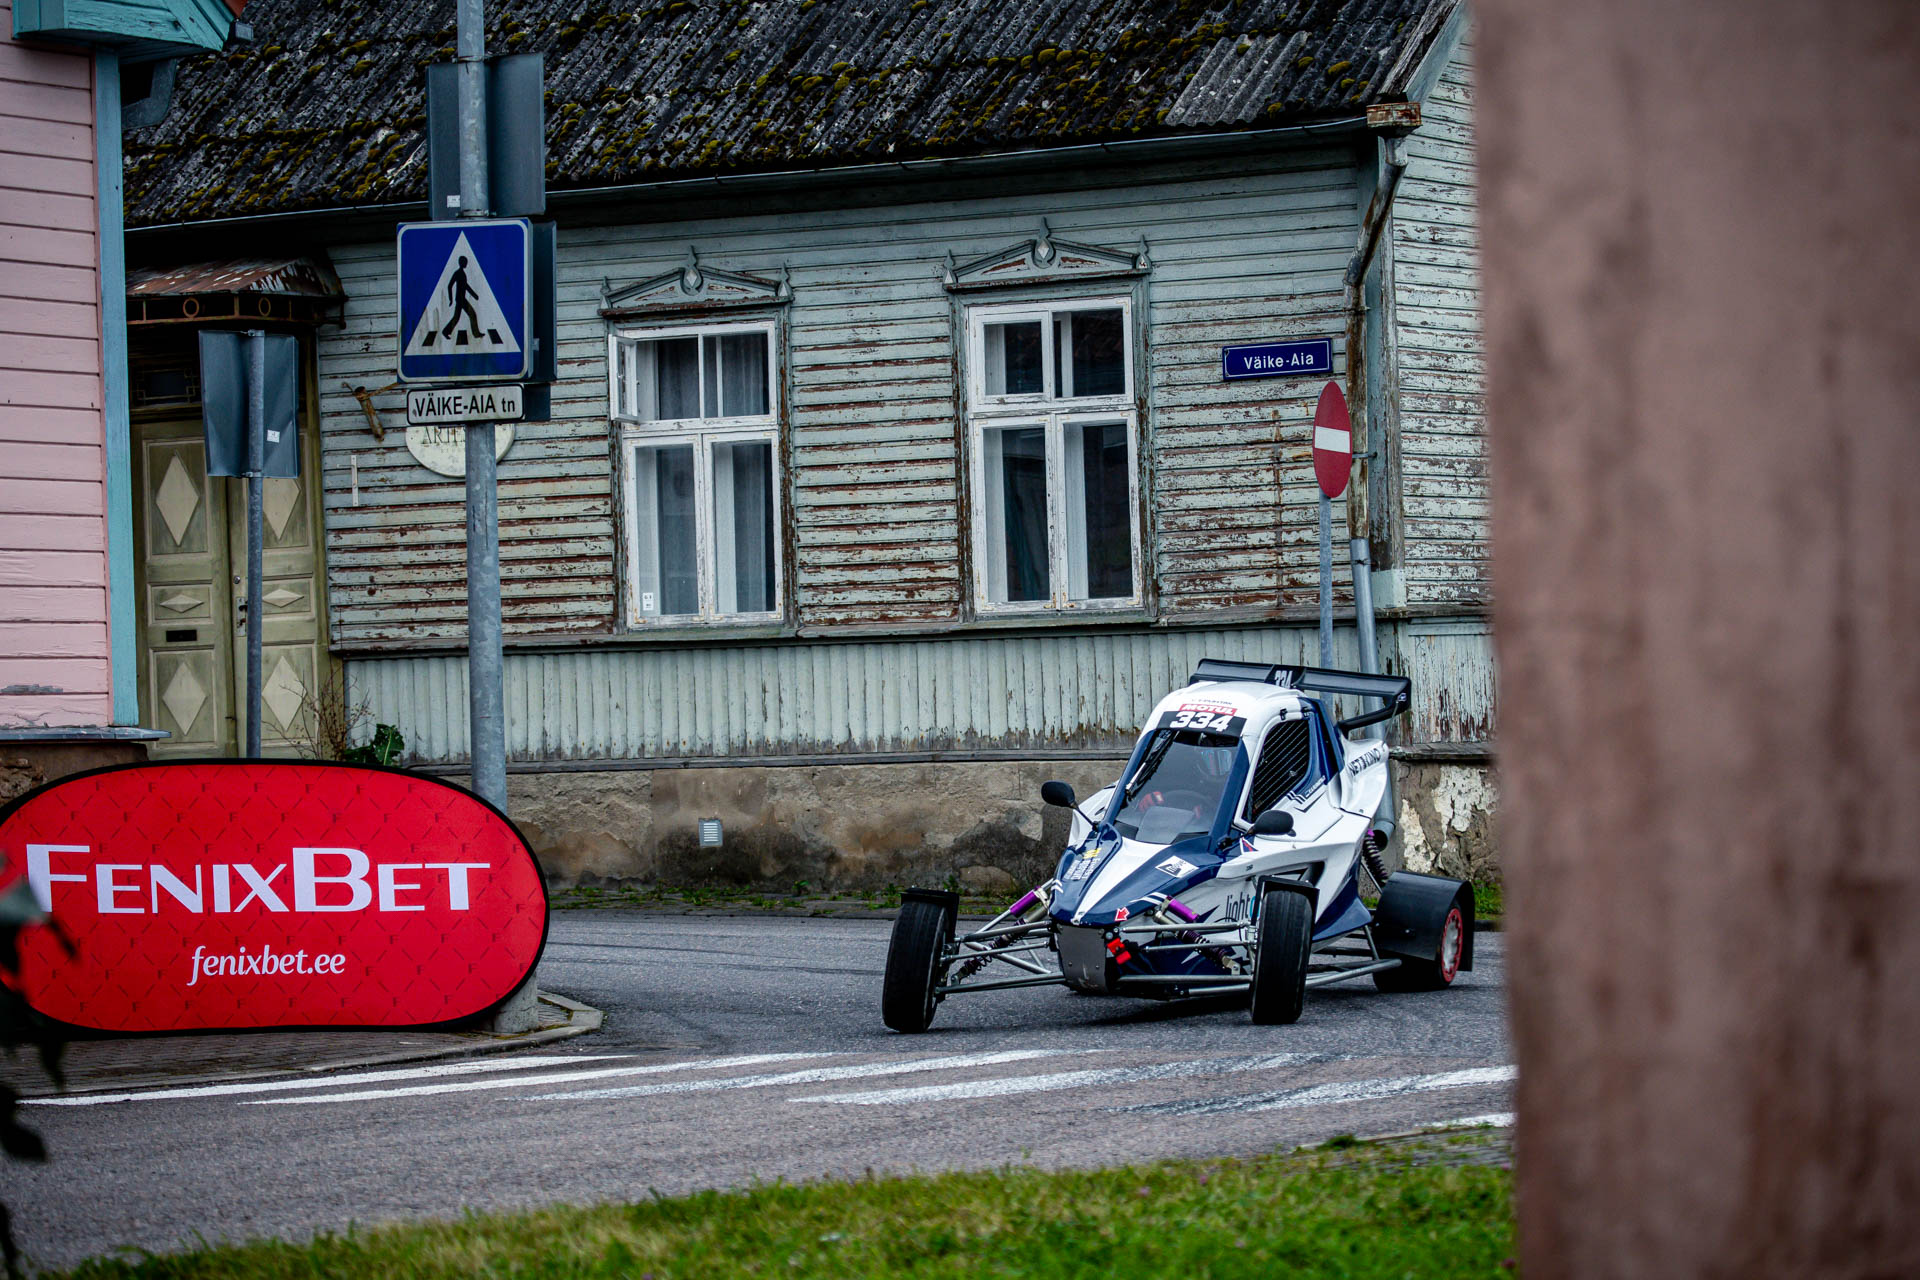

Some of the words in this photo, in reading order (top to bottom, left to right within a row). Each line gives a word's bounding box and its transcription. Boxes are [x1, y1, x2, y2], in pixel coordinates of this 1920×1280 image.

[1244, 353, 1314, 370] Väike-Aia
[415, 392, 496, 417] VÄIKE-AIA
[501, 398, 515, 413] tn
[1181, 703, 1235, 715] MOTUL
[1169, 711, 1233, 732] 334
[26, 843, 491, 914] FENIXBET
[187, 944, 346, 986] fenixbet.ee
